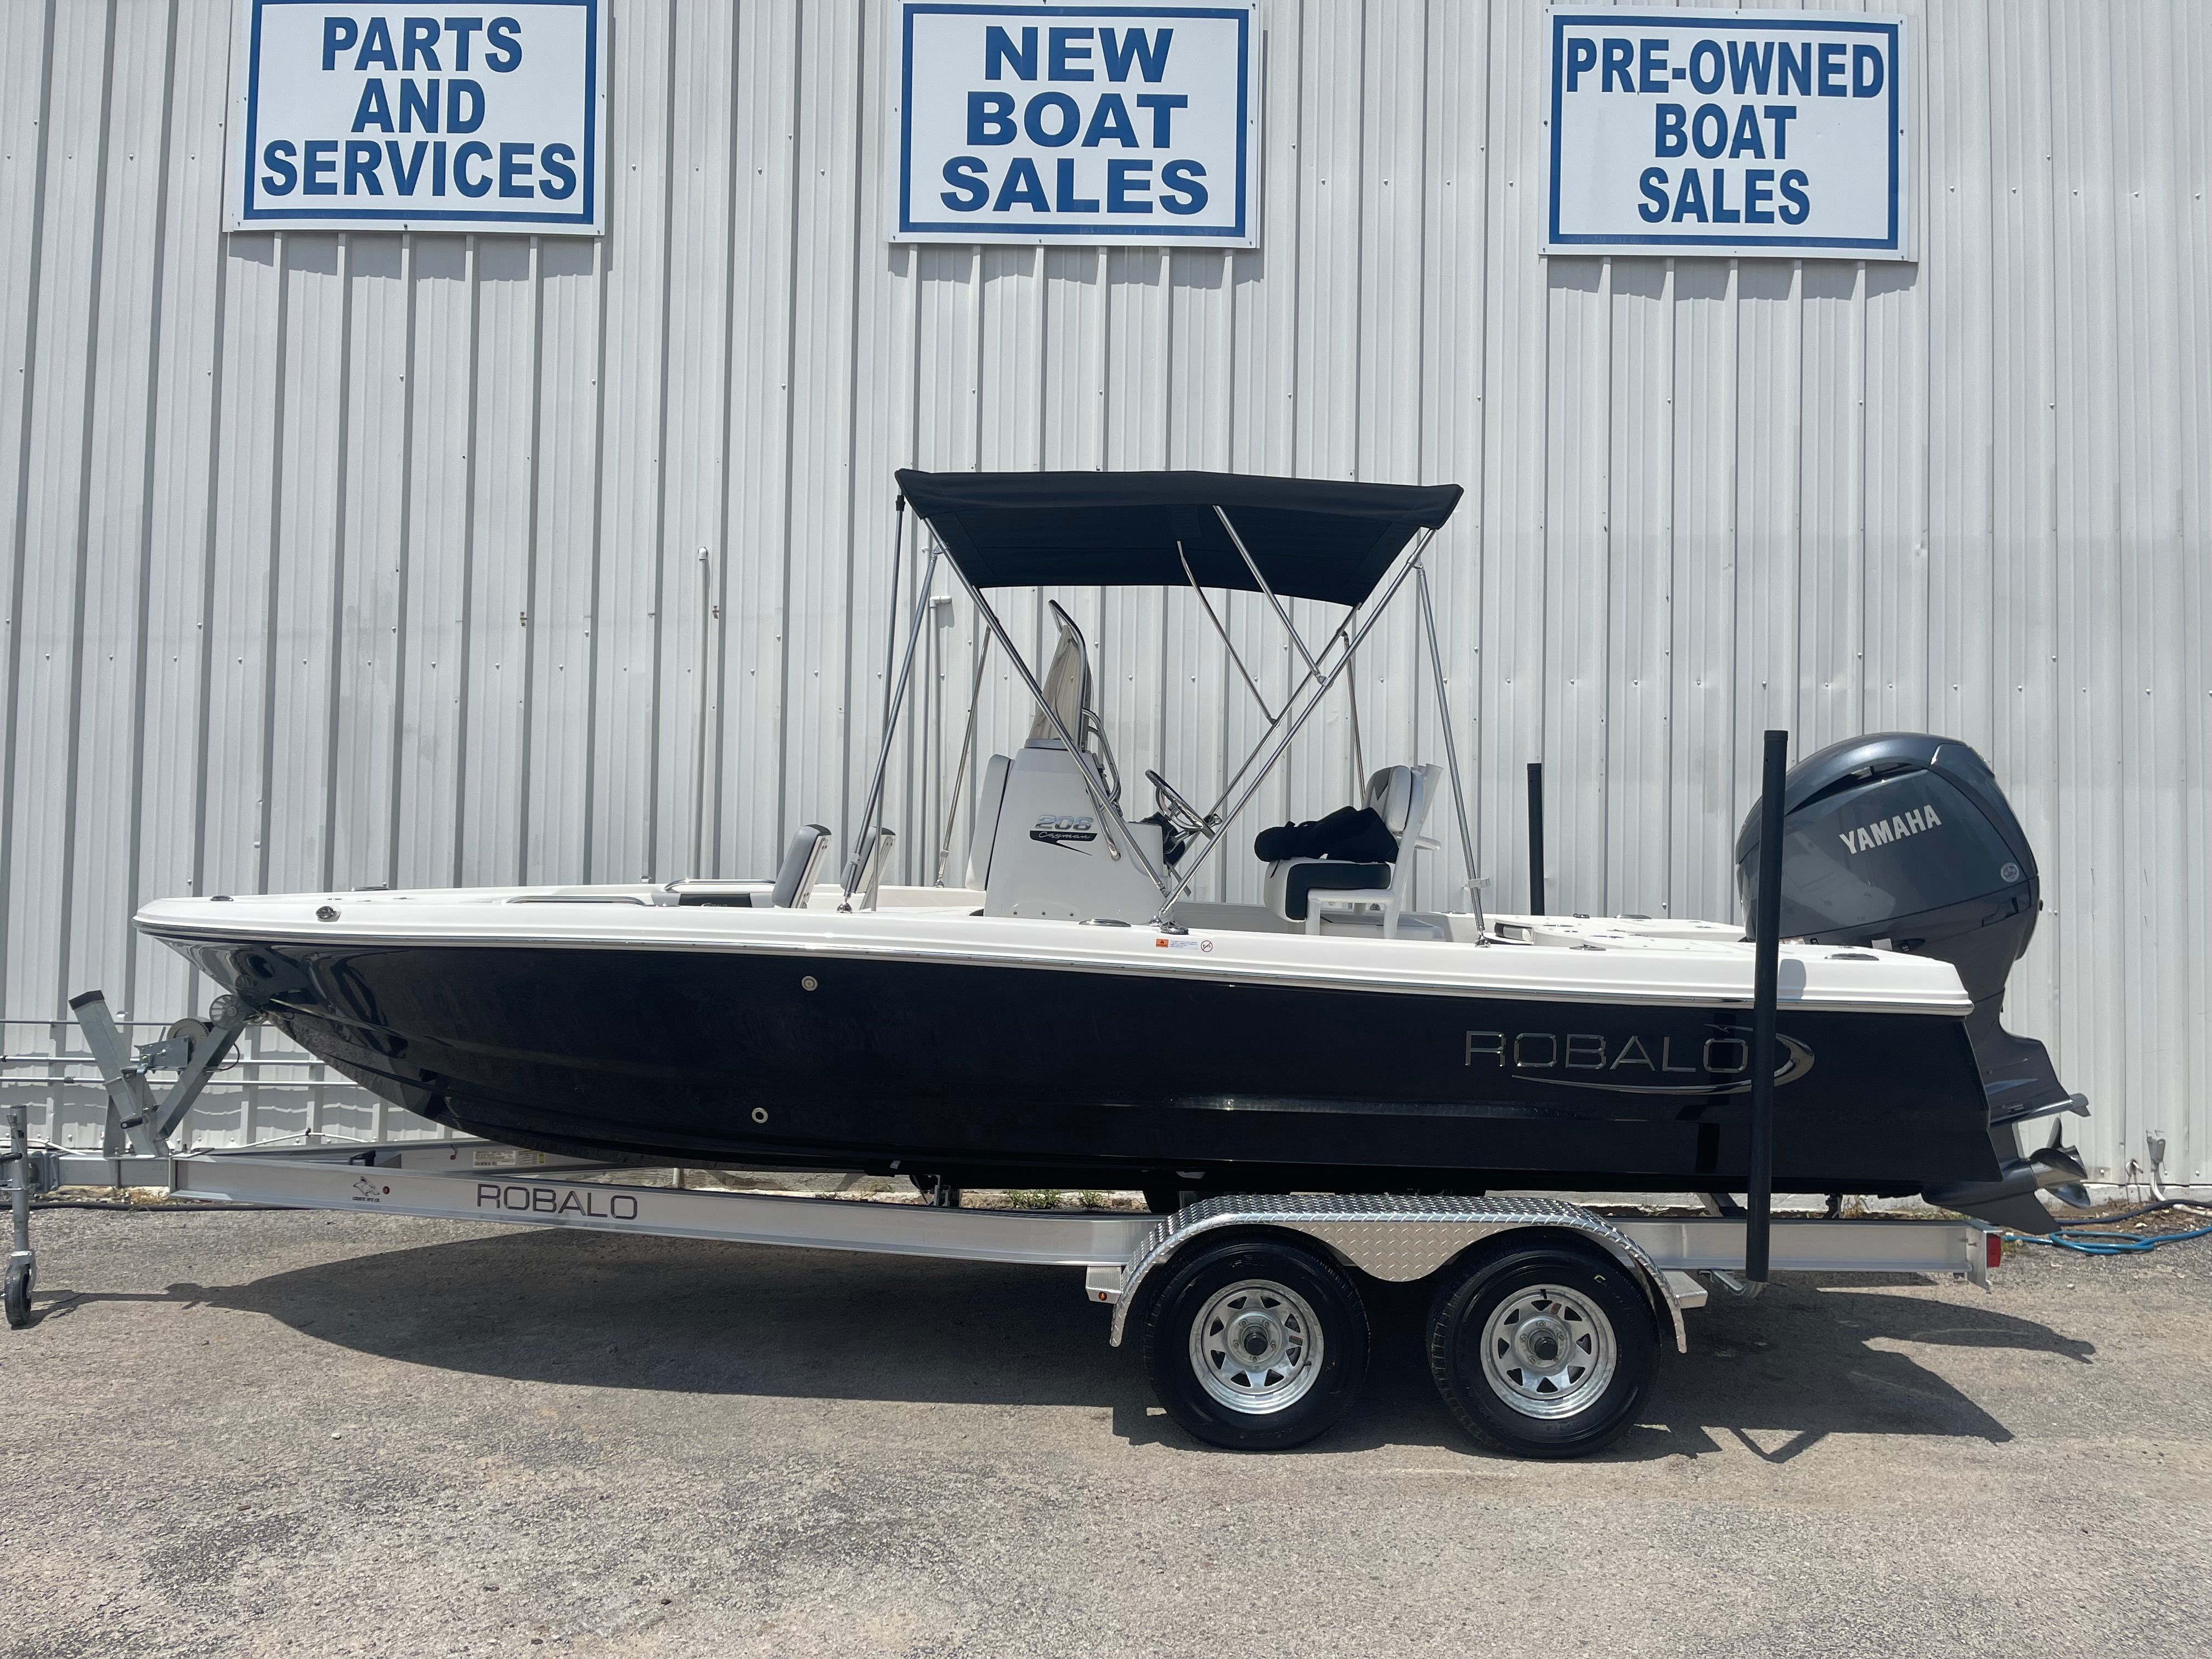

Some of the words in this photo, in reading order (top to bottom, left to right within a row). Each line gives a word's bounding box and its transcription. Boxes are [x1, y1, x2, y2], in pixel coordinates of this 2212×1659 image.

[322, 17, 522, 73] PARTS
[985, 26, 1173, 82] NEW
[1567, 38, 1884, 98] PRE-OWNED
[351, 78, 486, 133] AND
[967, 92, 1188, 148] BOAT
[1655, 103, 1797, 160] BOAT
[261, 140, 577, 200] SERVICES
[940, 156, 1208, 215] SALES
[1638, 167, 1810, 225] SALES
[1035, 815, 1094, 830] 206
[1839, 804, 1942, 854] YAMAHA
[1465, 1030, 1749, 1073] ROBALO
[477, 1184, 637, 1220] ROBALO
